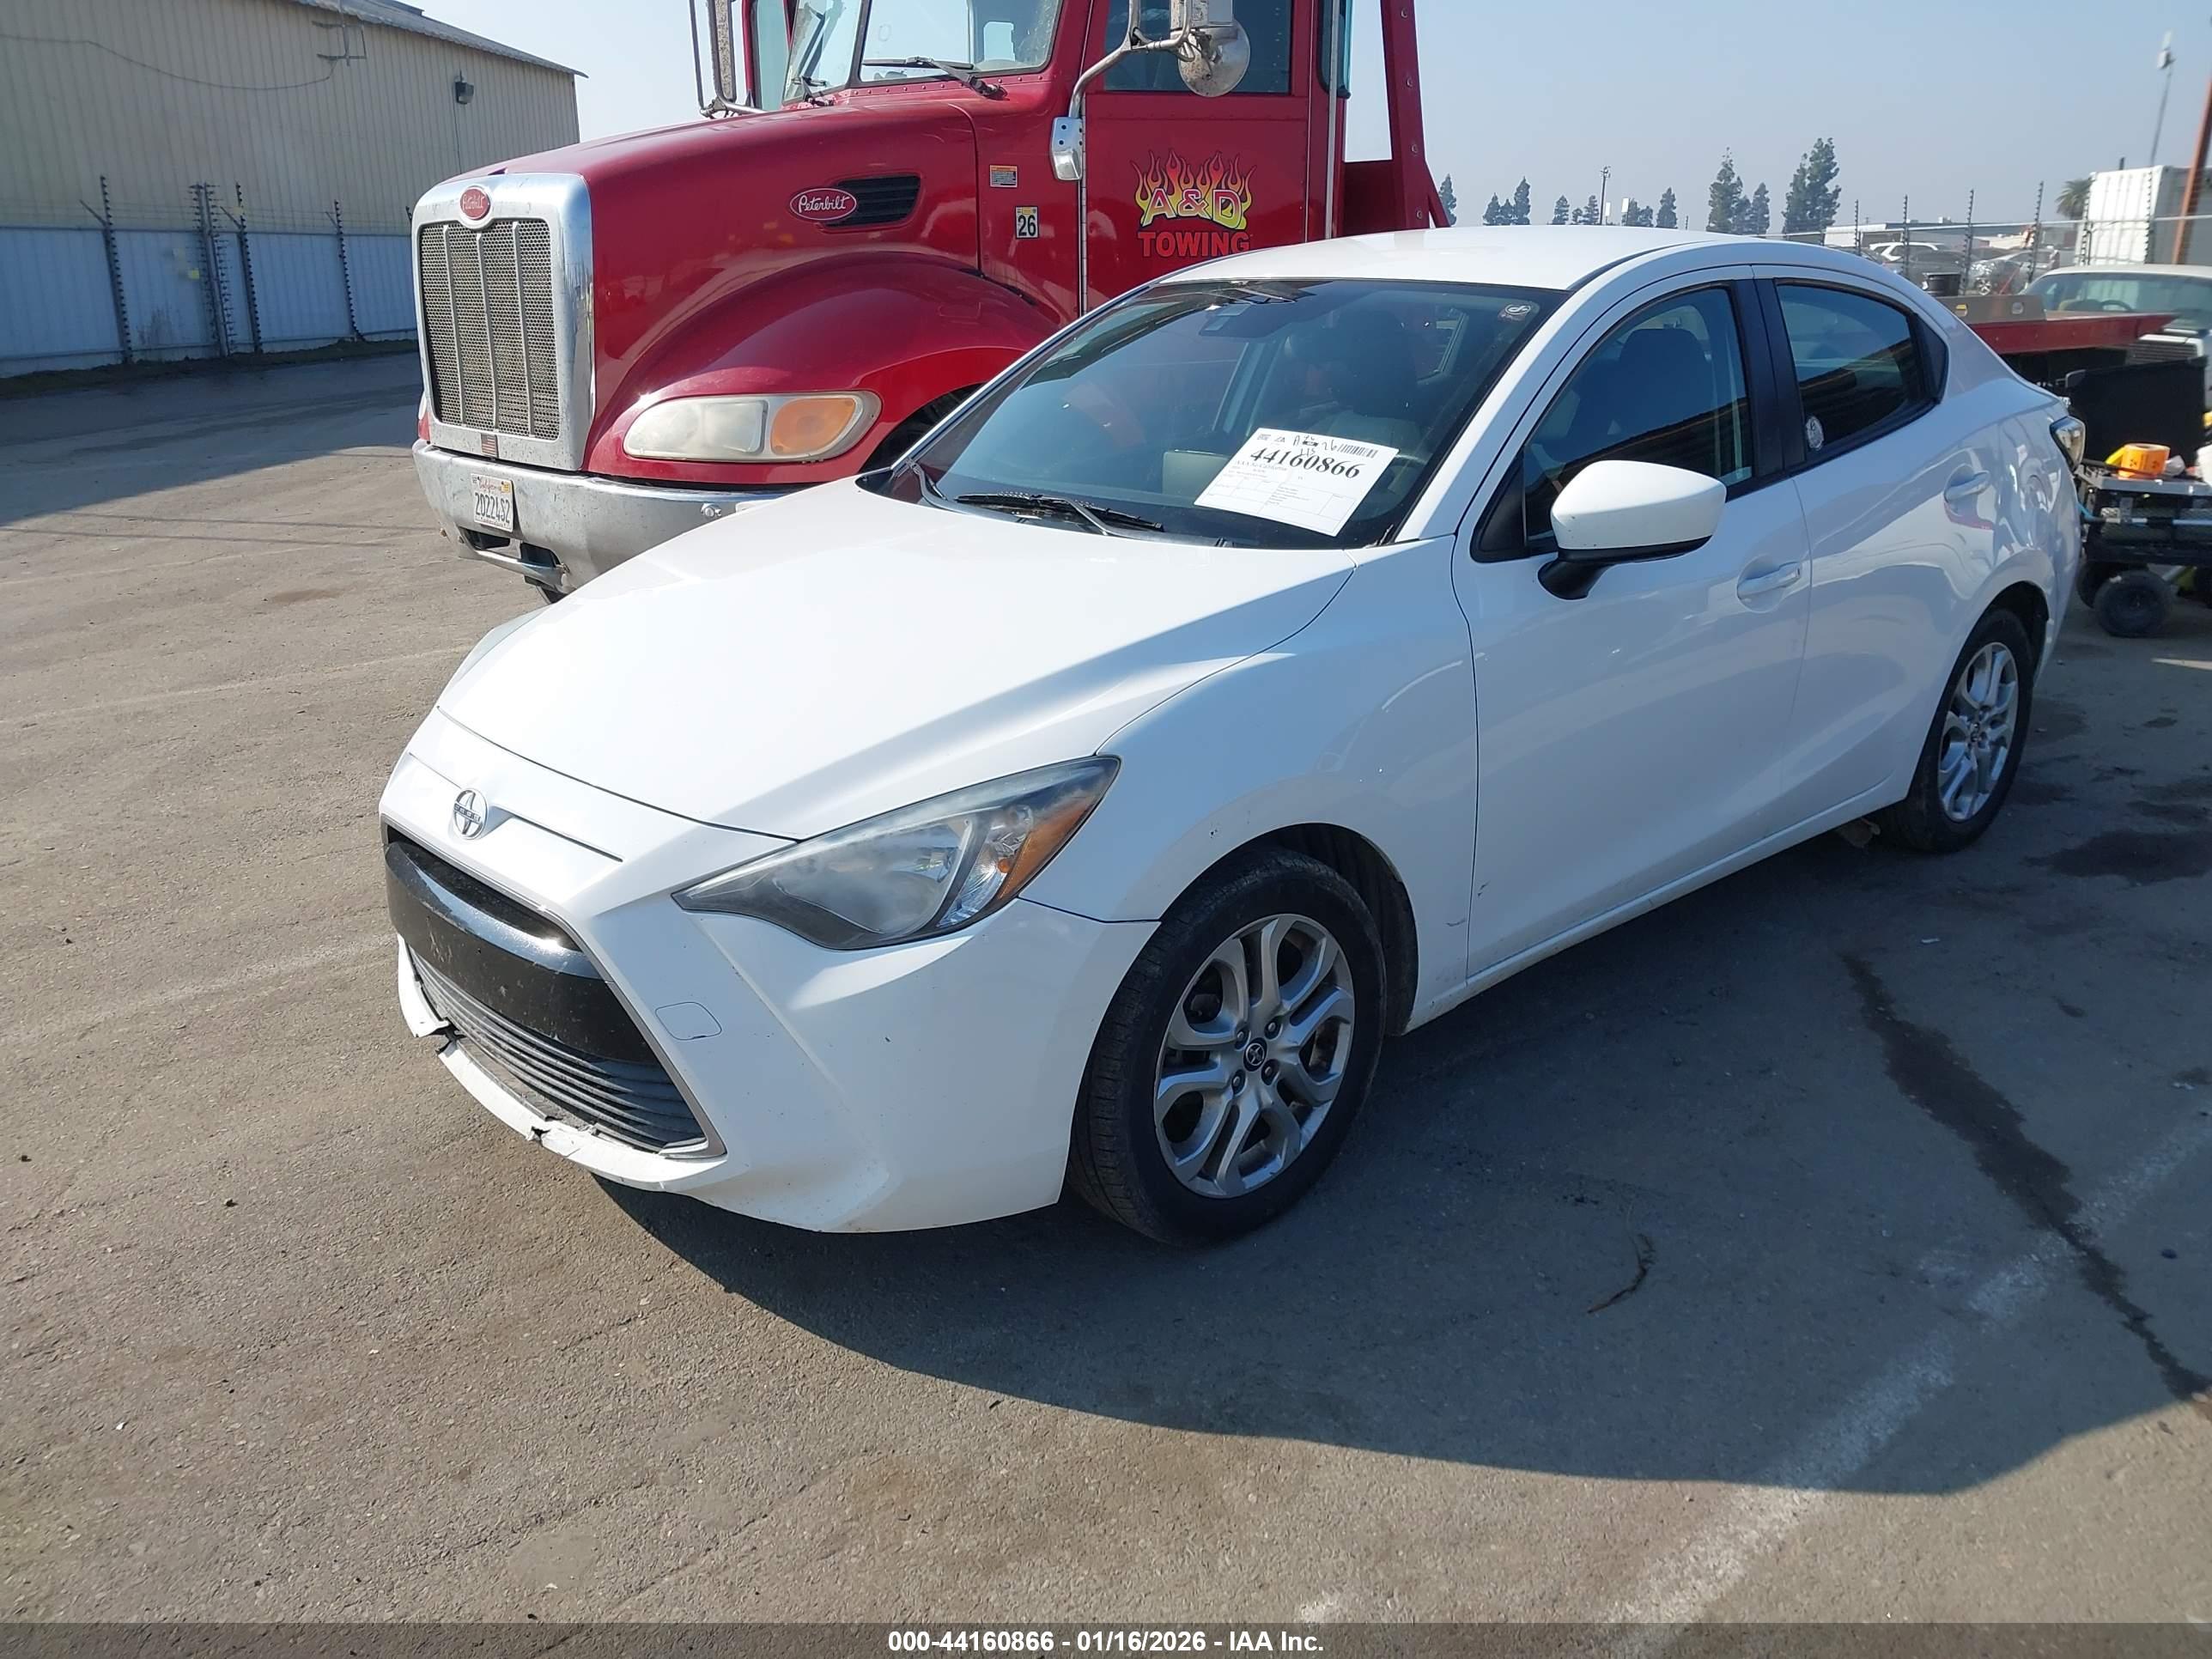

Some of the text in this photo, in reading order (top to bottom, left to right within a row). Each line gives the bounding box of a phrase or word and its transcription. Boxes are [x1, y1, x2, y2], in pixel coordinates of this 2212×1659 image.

[798, 194, 851, 214] Peterbilt
[1142, 188, 1243, 229] A&D
[1018, 214, 1036, 237] 26
[1138, 231, 1250, 258] TOWING
[1250, 447, 1366, 479] 44160866
